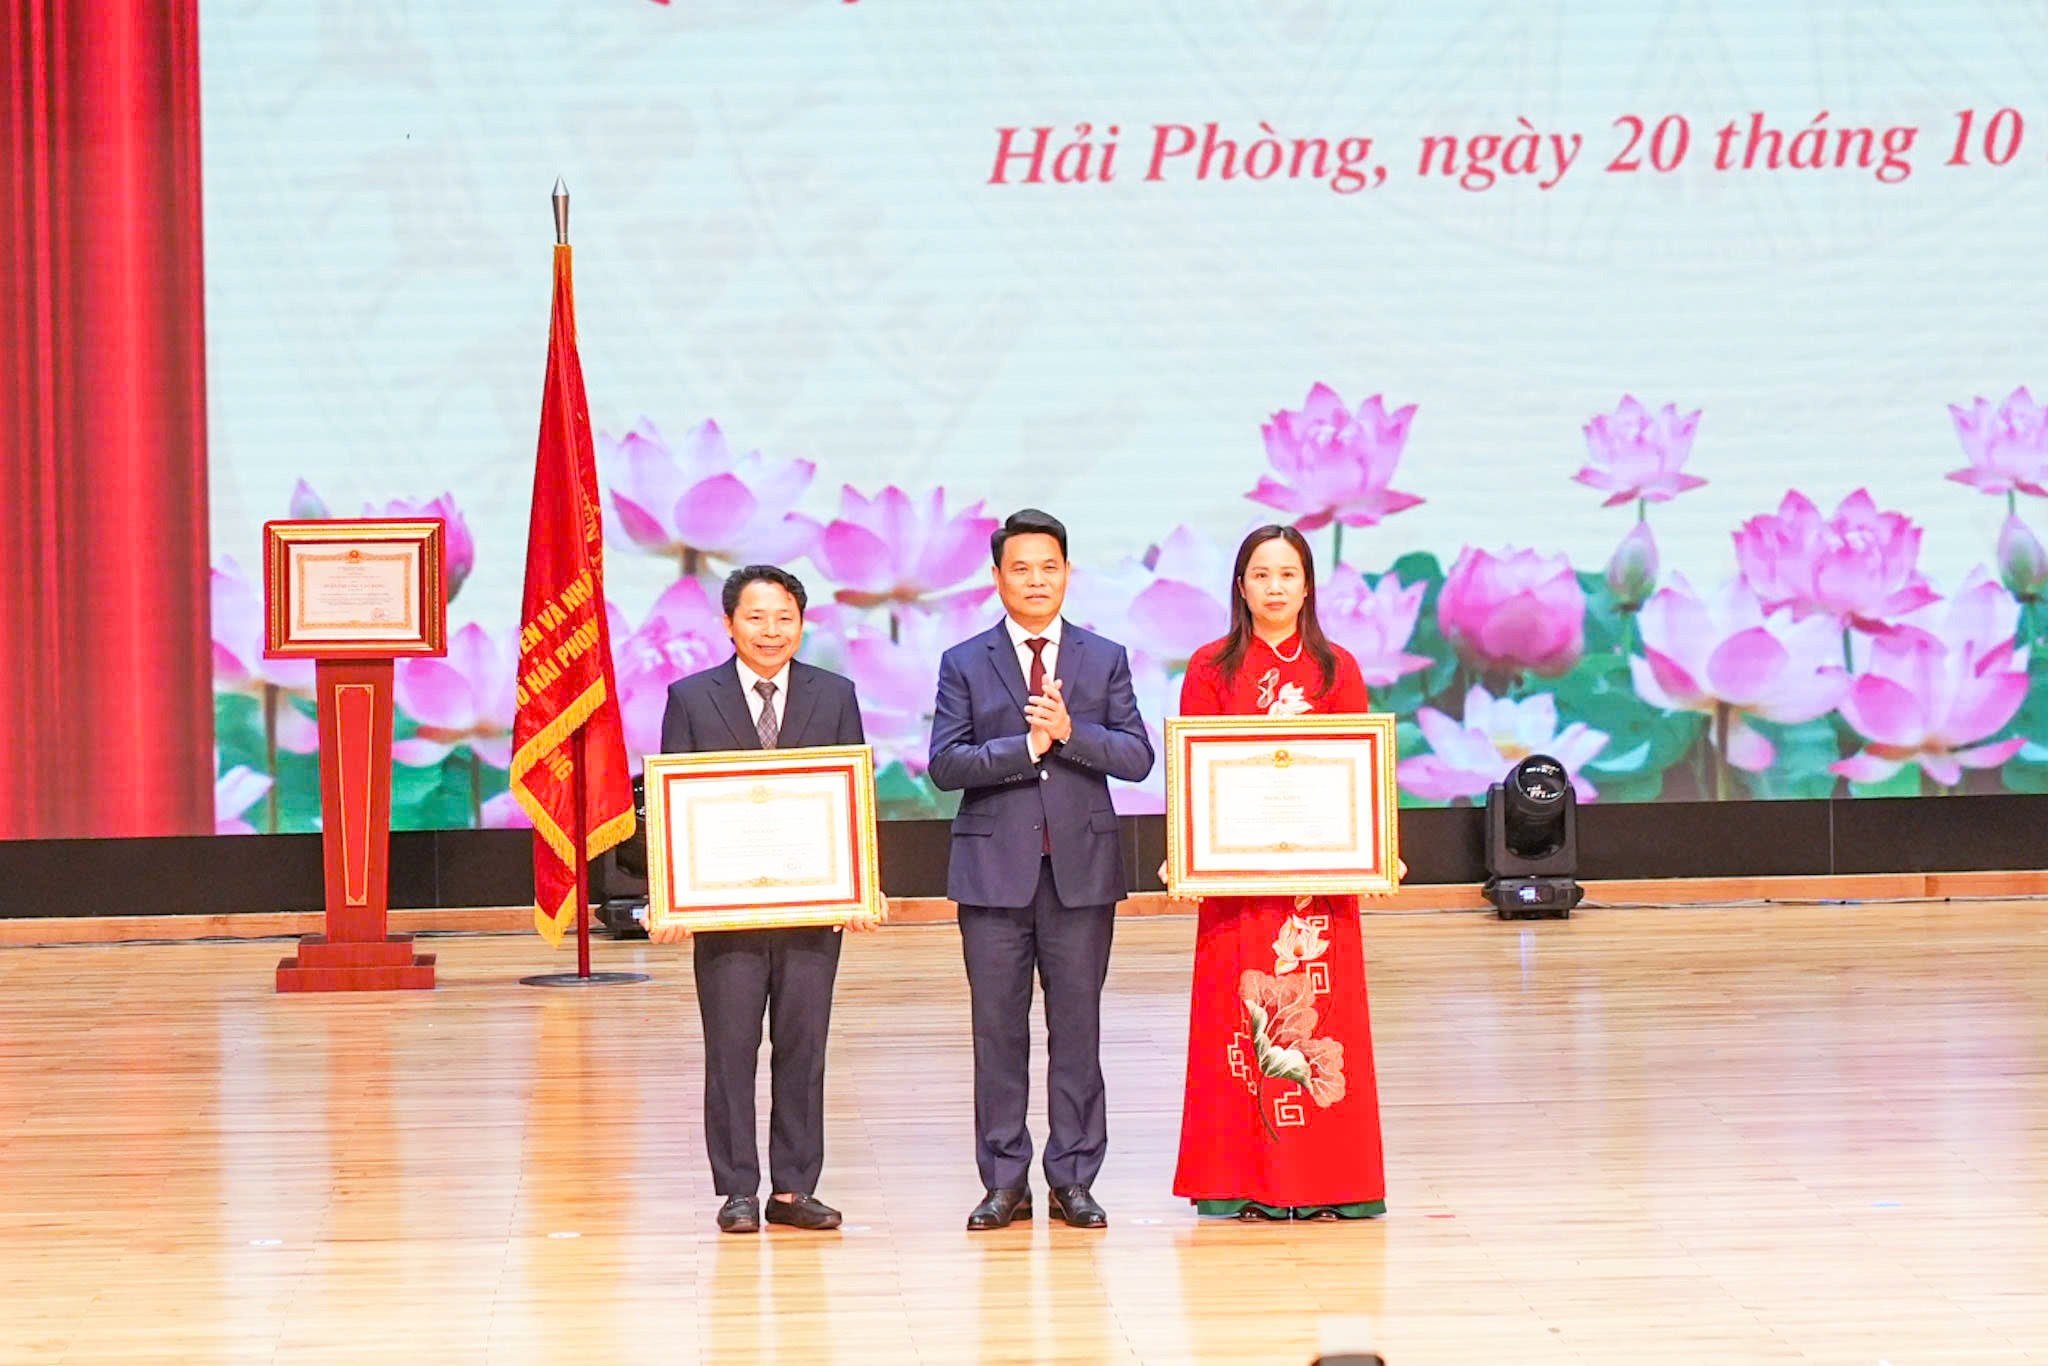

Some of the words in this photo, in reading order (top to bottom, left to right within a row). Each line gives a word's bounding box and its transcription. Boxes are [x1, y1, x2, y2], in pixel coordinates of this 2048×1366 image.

[989, 124, 1119, 184] Hải
[1146, 122, 1387, 192] Phòng,
[1417, 117, 1581, 189] ngày
[1607, 114, 1689, 172] 20
[1714, 111, 1918, 181] tháng
[1944, 108, 2023, 166] 10
[524, 656, 562, 694] HẢI
[554, 612, 600, 669] PHÒN
[537, 599, 568, 632] VÀ
